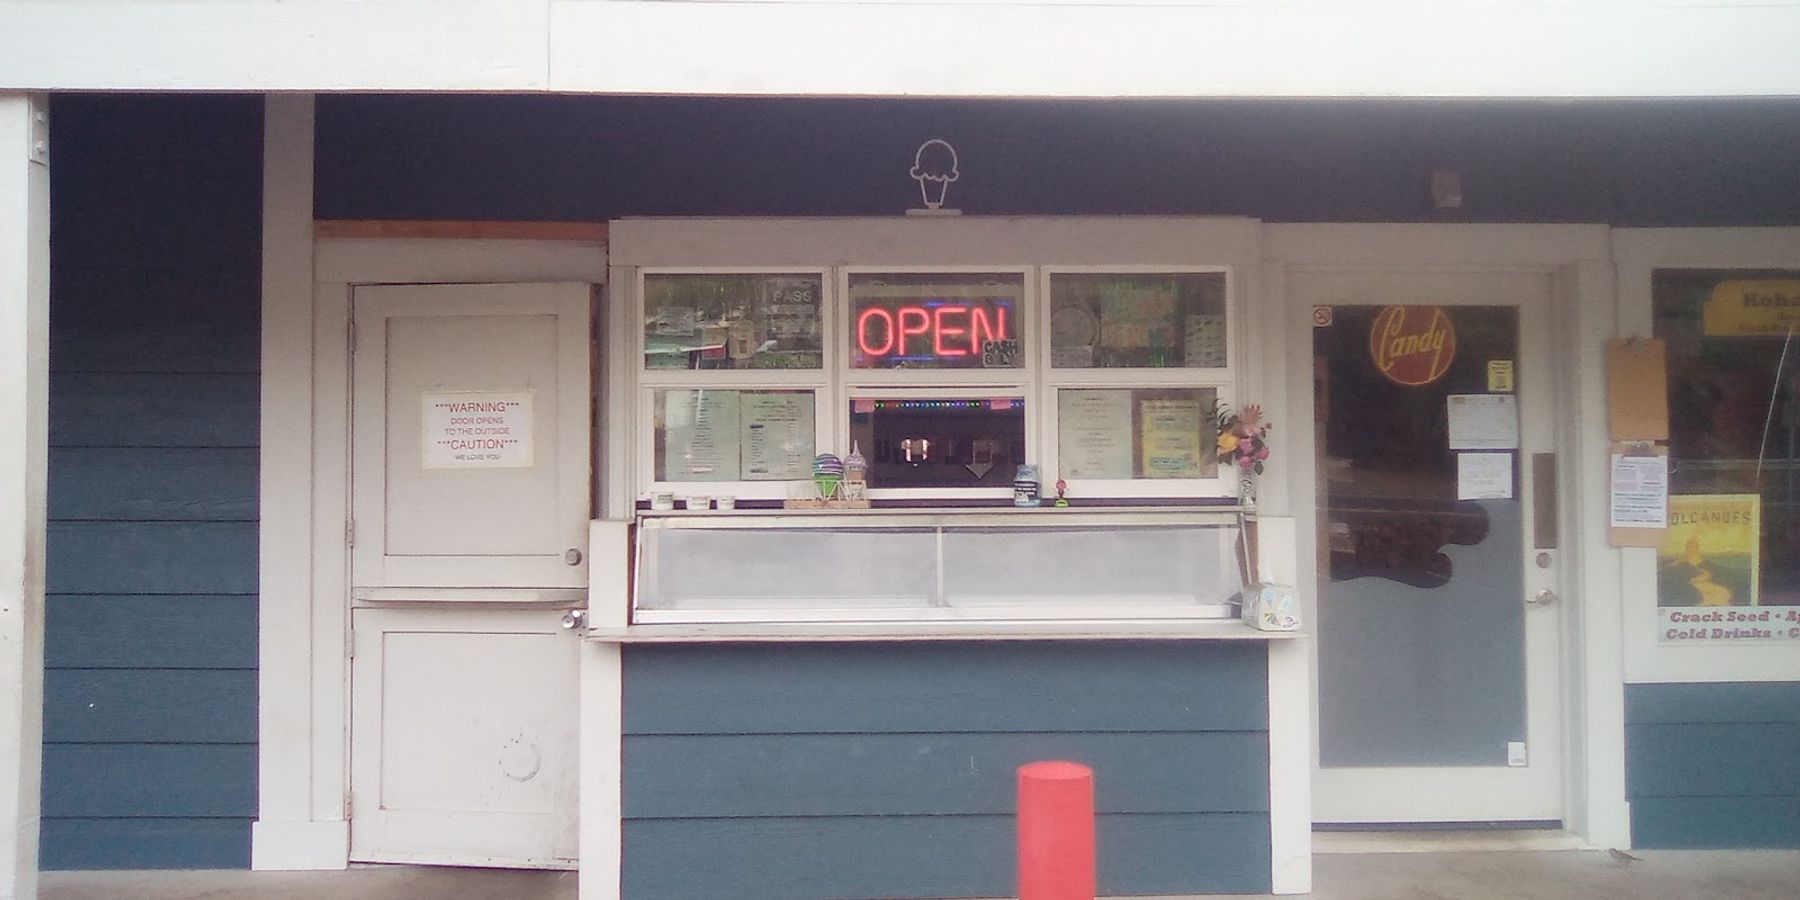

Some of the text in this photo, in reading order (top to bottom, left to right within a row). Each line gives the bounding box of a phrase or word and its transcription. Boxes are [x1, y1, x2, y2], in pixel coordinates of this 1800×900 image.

[857, 306, 1006, 356] OPEN
[1378, 304, 1447, 382] Candy
[450, 416, 504, 425] DOOR OPENS
[475, 427, 511, 435] OUTSIDE
[1670, 511, 1751, 525] OLCANOES
[1670, 611, 1723, 622] Crack
[1727, 611, 1770, 622] Seed
[1666, 628, 1707, 639] Cold
[1711, 627, 1771, 639] Drinks
